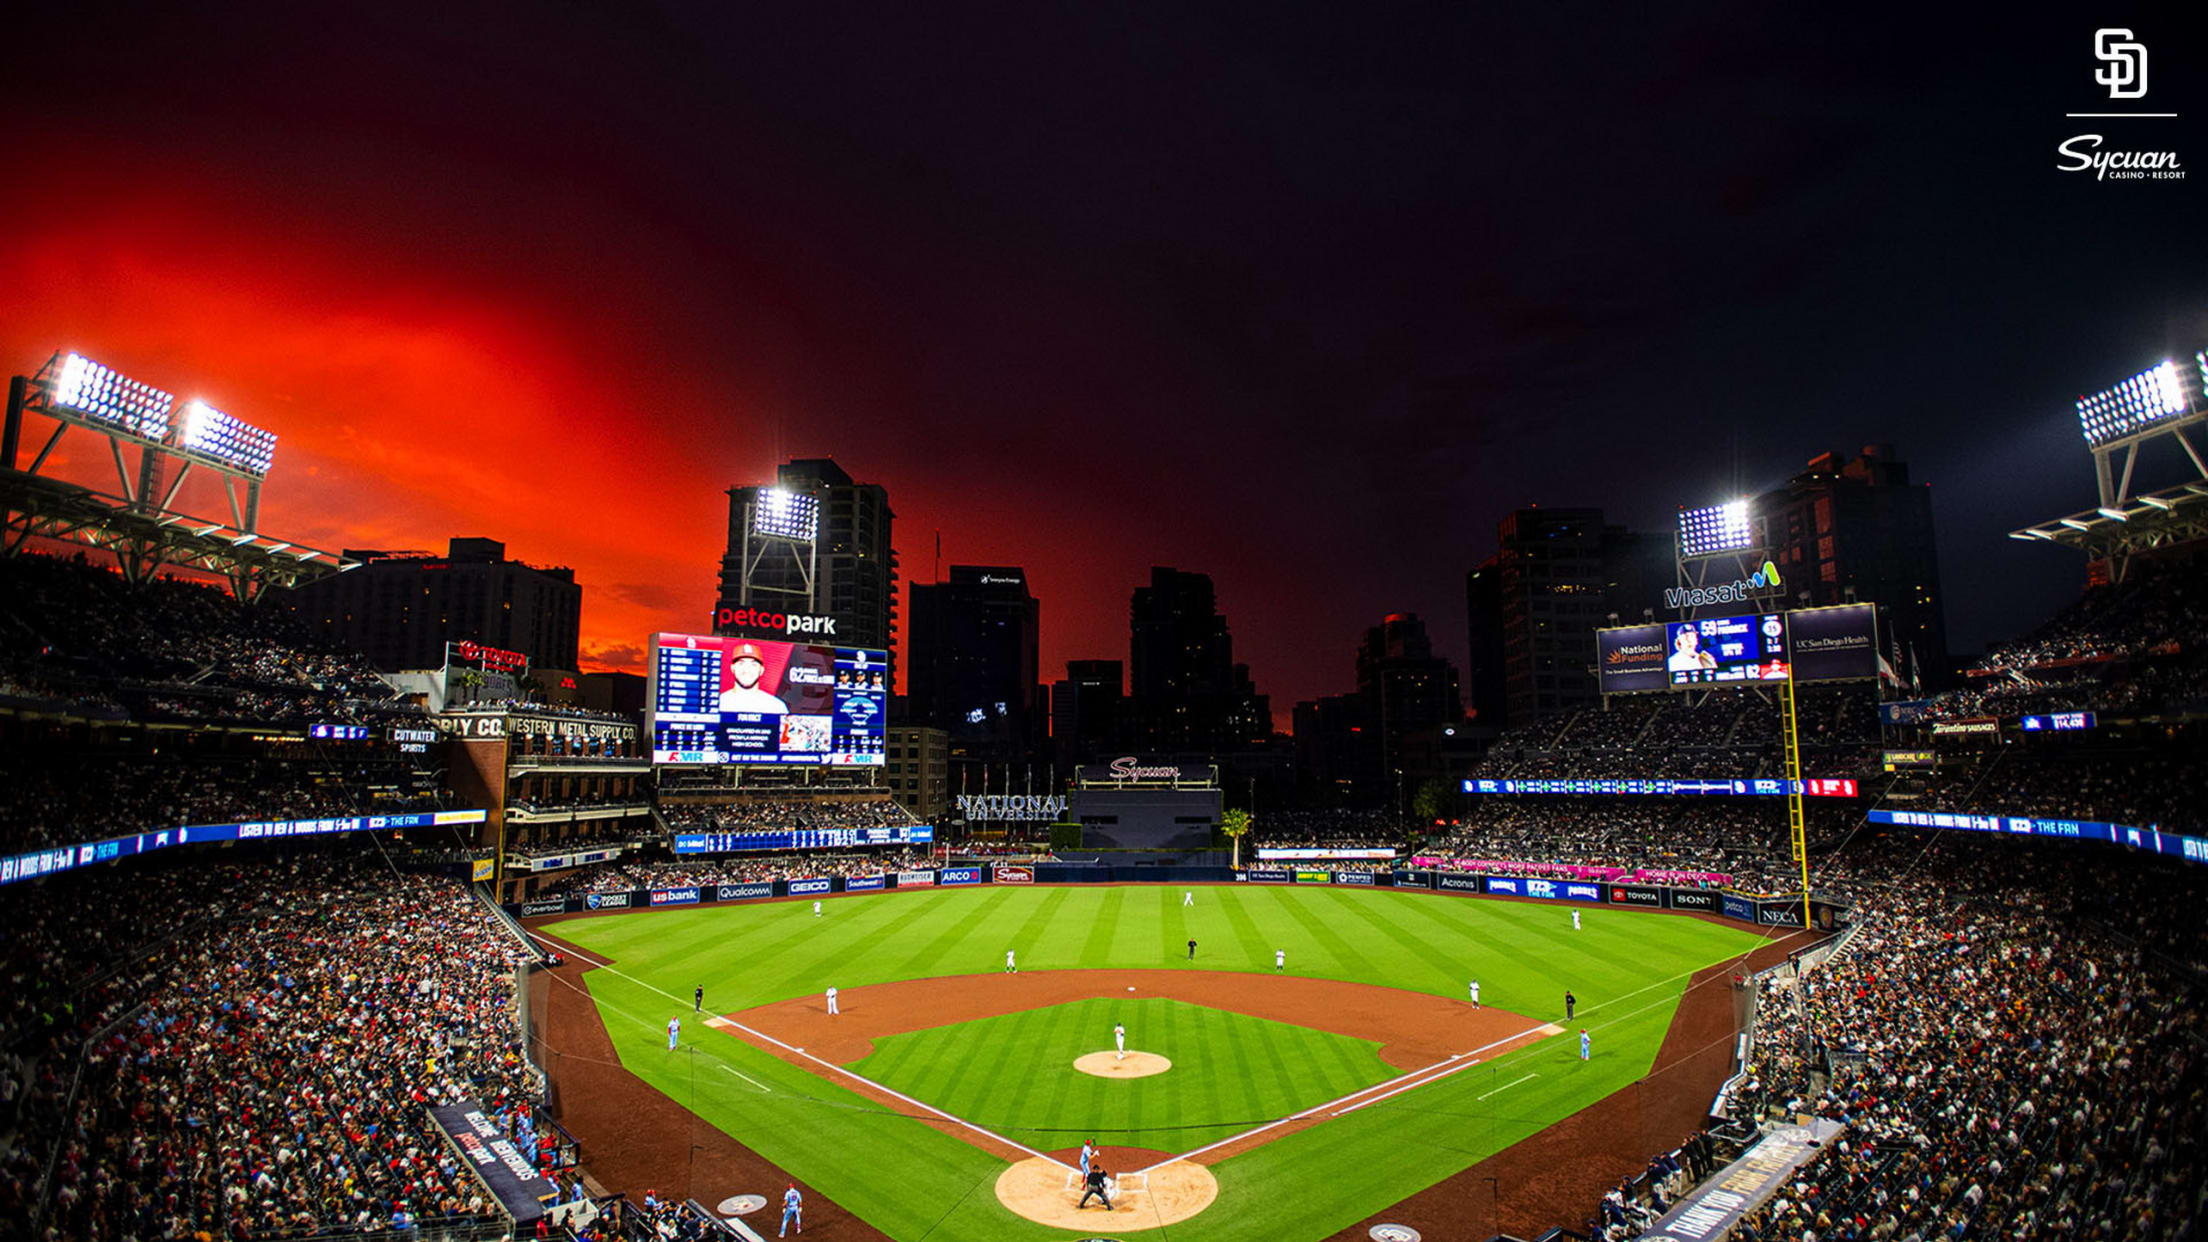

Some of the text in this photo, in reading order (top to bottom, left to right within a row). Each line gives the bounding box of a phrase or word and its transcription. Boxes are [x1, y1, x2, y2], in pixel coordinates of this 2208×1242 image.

[1665, 580, 1747, 609] Viasat
[1796, 635, 1869, 648] UC San Diego Health
[1620, 643, 1663, 655] National
[480, 646, 527, 668] TOYOTA
[1621, 653, 1664, 663] Funding
[477, 718, 506, 737] CO.
[508, 718, 636, 740] WESTERN METAL SUPPLY CO.
[394, 729, 436, 742] CUTWATER
[400, 743, 426, 753] SPIRITS
[1109, 756, 1181, 783] Sycuan
[956, 794, 1069, 811] NATIONAL
[391, 816, 404, 827] THE
[405, 815, 419, 825] FAN
[966, 808, 1060, 821] UNIVERSITY
[2037, 821, 2056, 833] THE
[2058, 822, 2079, 835] FAN
[943, 872, 970, 881] ARCO
[790, 881, 829, 892] GEICO
[1441, 878, 1475, 889] Acronis
[719, 887, 770, 898] Qualcomm
[1627, 892, 1657, 901] TOYOTA
[602, 899, 628, 907] LEAGUE
[1677, 895, 1712, 905] SONY
[1763, 910, 1799, 924] NECA
[1665, 1189, 1745, 1239] THANK YOU
